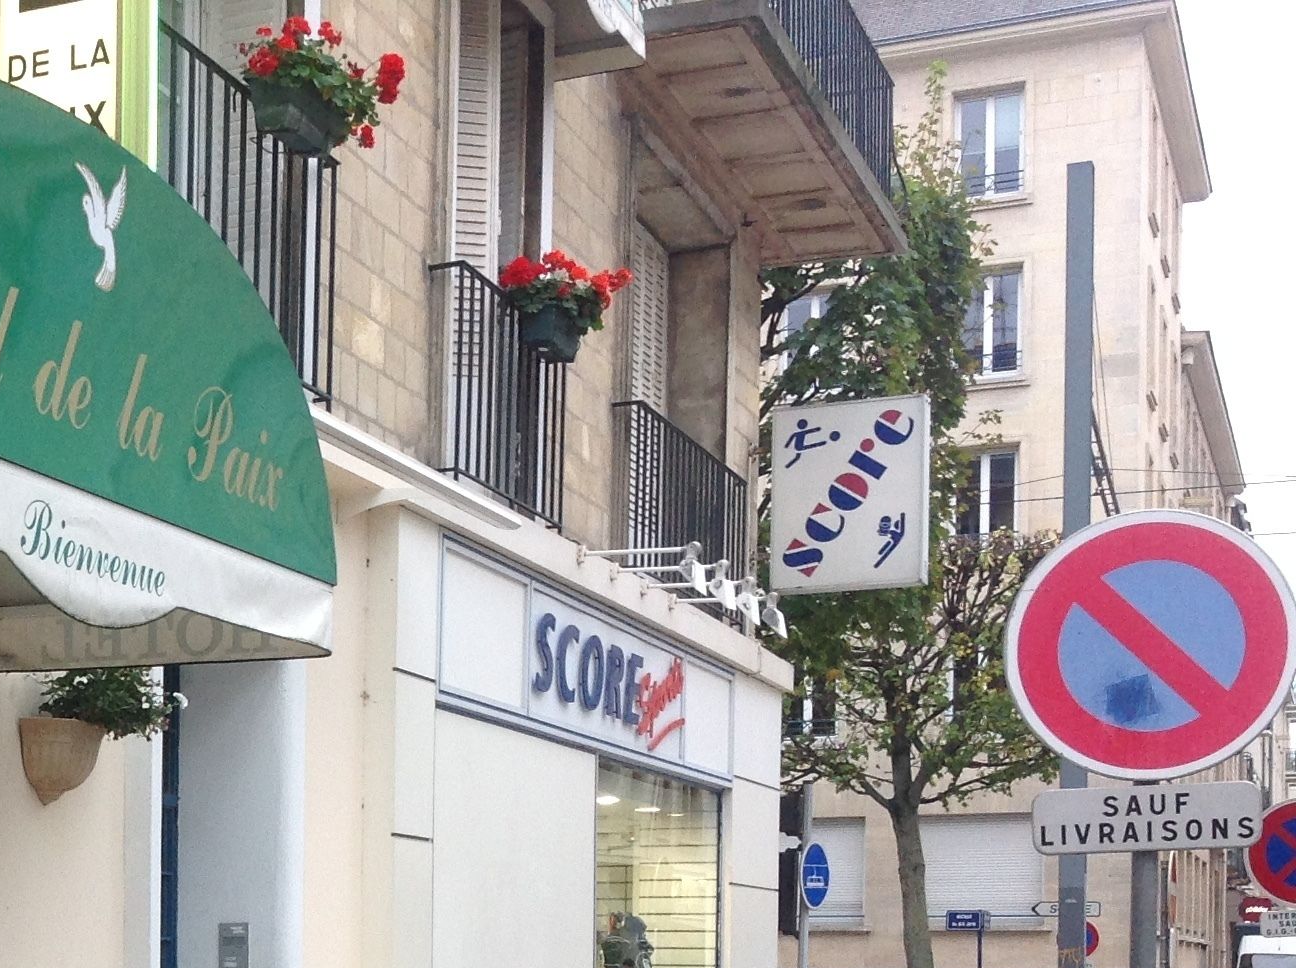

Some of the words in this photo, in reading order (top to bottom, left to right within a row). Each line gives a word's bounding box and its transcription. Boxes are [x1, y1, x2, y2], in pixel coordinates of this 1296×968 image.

[8, 49, 50, 83] DE
[70, 38, 110, 71] LA
[34, 320, 92, 430] de
[117, 353, 164, 462] la
[186, 385, 285, 512] Paix
[20, 499, 166, 598] Bienvenue
[532, 612, 645, 725] SCORE
[1040, 816, 1255, 847] LIVRAISONS
[1102, 792, 1190, 817] SAUF
